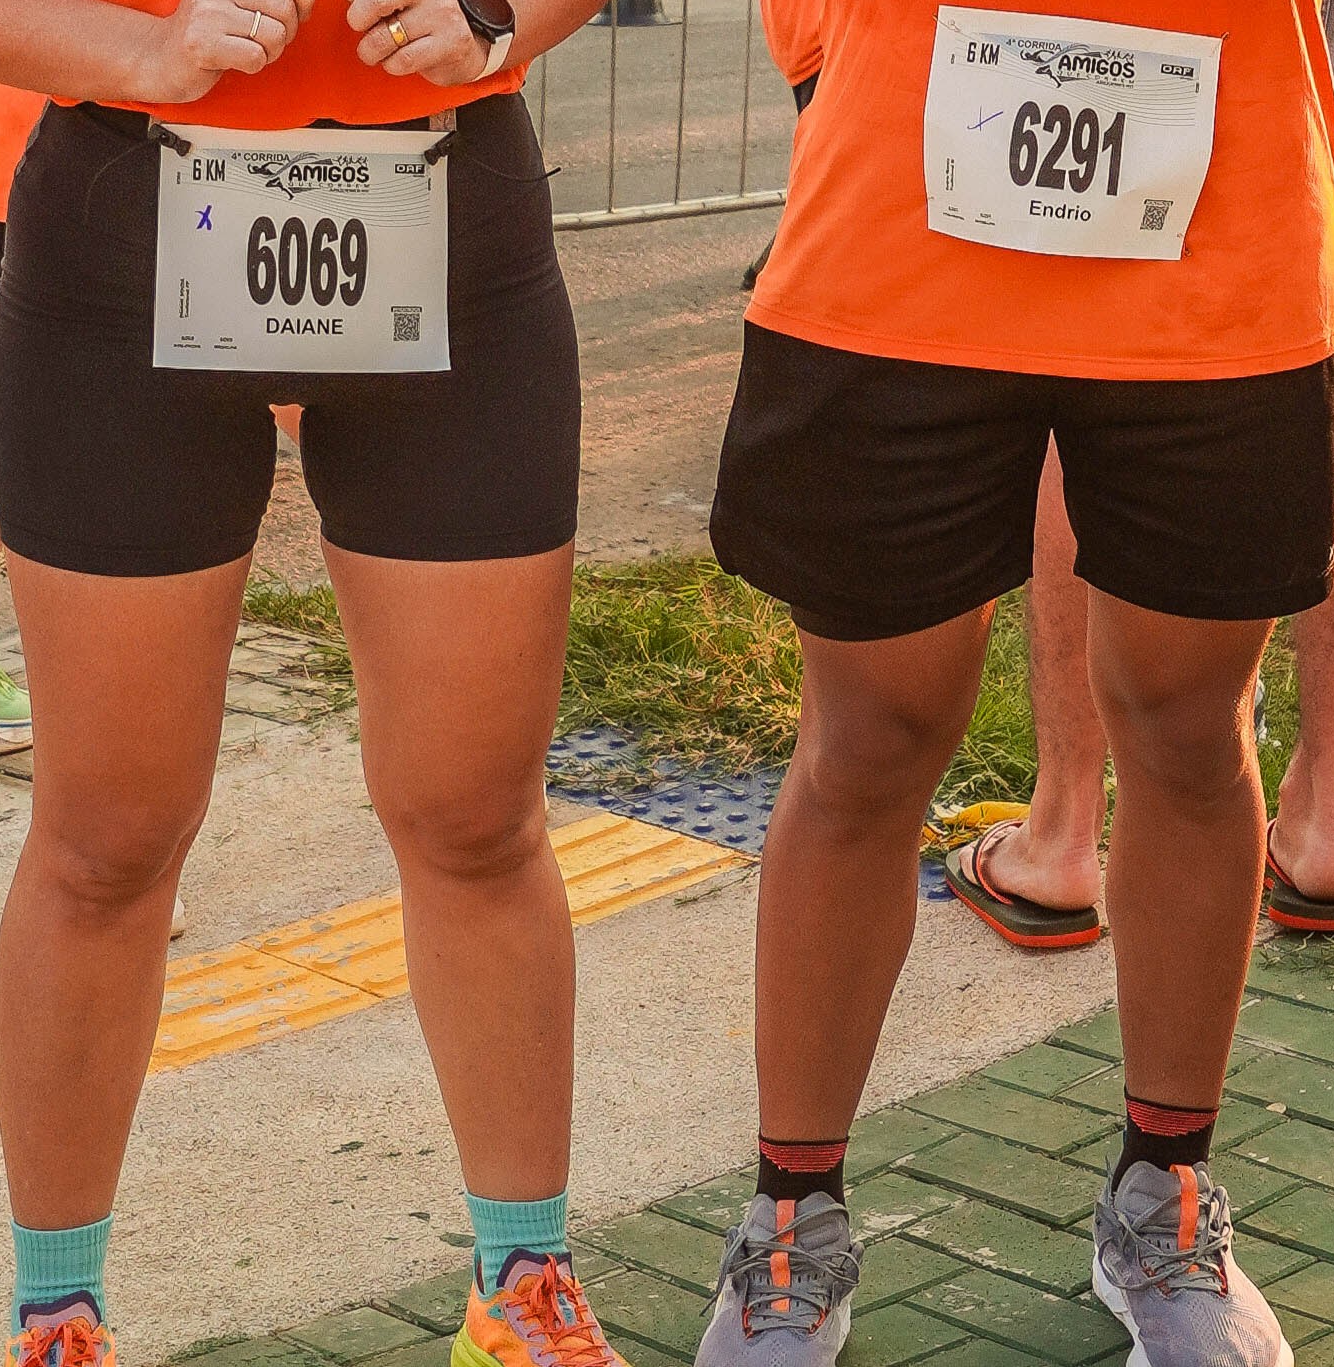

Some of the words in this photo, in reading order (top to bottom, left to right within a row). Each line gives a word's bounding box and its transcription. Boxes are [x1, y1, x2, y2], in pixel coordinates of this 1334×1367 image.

[967, 41, 977, 63] 6
[980, 43, 1001, 66] KM
[1017, 39, 1063, 51] CORRIDA
[1058, 54, 1136, 79] AMIGOS
[244, 152, 291, 163] CORRIDA
[1008, 100, 1127, 197] 6291
[192, 158, 202, 181] 6
[206, 159, 226, 182] KM
[288, 164, 370, 184] AMIGOS
[1029, 199, 1092, 223] Endrio
[246, 215, 368, 307] 6069
[266, 317, 344, 336] DAIANE
